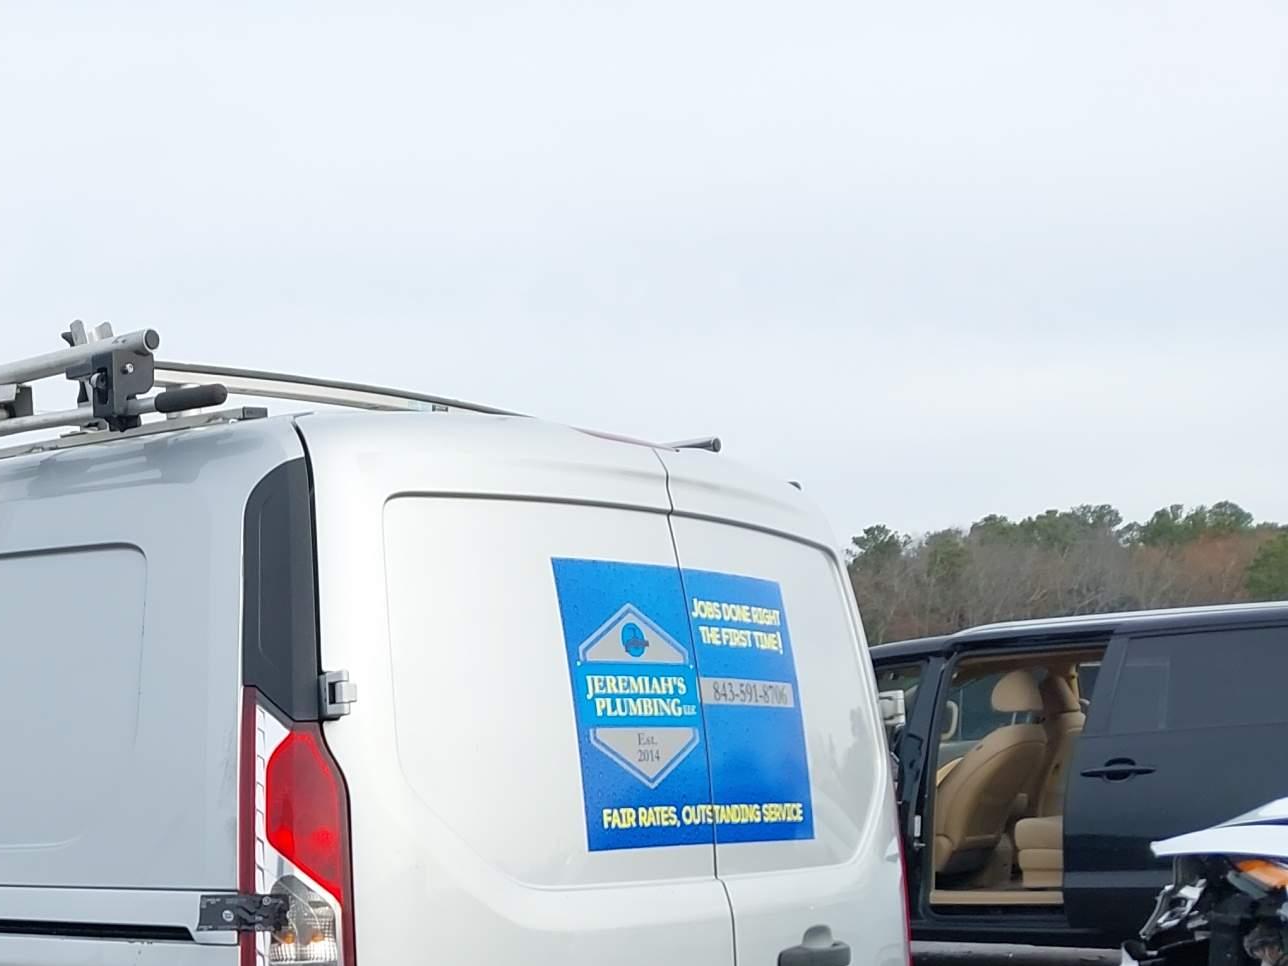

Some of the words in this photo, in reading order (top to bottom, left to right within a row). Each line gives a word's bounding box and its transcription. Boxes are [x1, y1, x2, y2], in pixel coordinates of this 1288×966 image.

[692, 597, 722, 621] JOBS
[699, 626, 722, 645] THE
[586, 675, 687, 700] JEREMIAH'S
[595, 697, 683, 717] PLUMBING
[602, 807, 636, 829] FAIR
[638, 805, 681, 828] RATES,
[681, 803, 761, 825] OUTSTANDING
[762, 802, 804, 823] SERVICE
